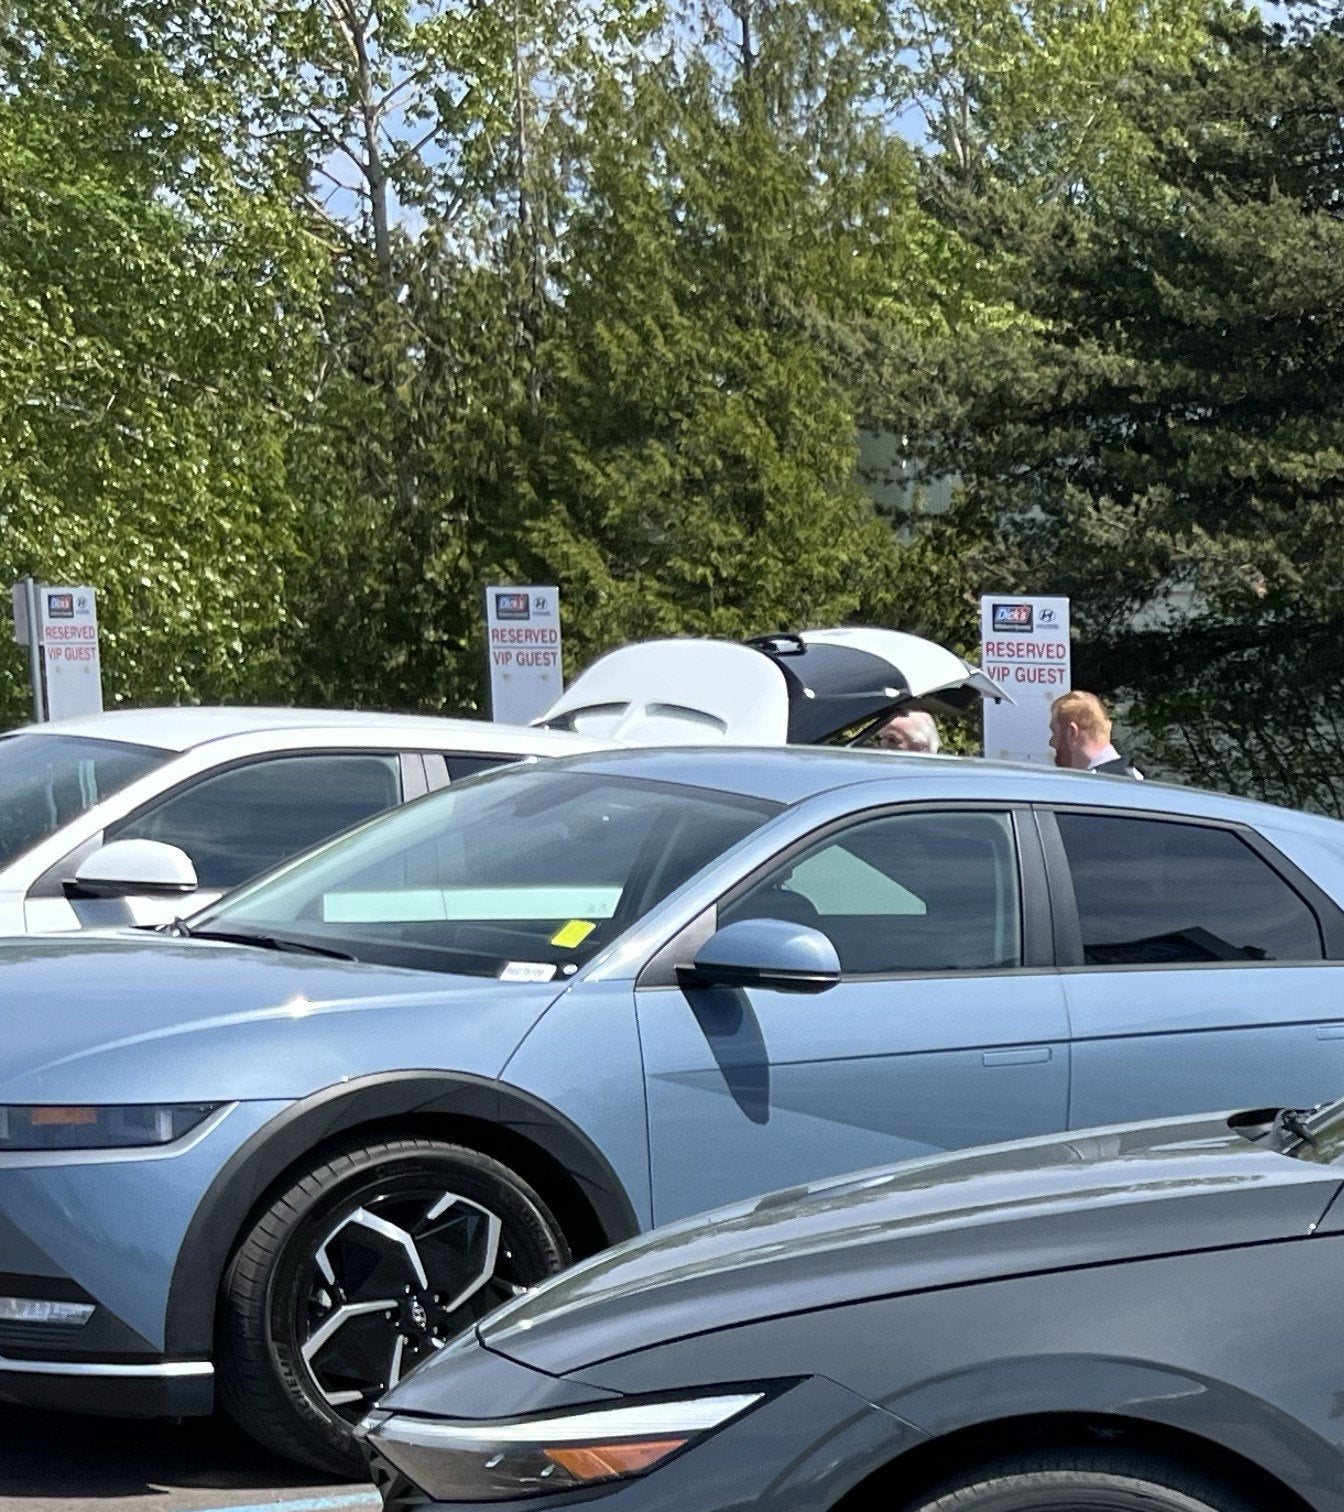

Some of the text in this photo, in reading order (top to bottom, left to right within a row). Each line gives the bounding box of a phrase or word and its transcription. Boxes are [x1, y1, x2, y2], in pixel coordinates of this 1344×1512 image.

[45, 625, 96, 640] RESERVED
[491, 628, 558, 644] RESERVED
[47, 646, 96, 661] VIP GUEST
[985, 641, 1067, 660] RESERVED
[493, 651, 558, 667] VIP GUEST
[987, 666, 1066, 685] VIP GUEST
